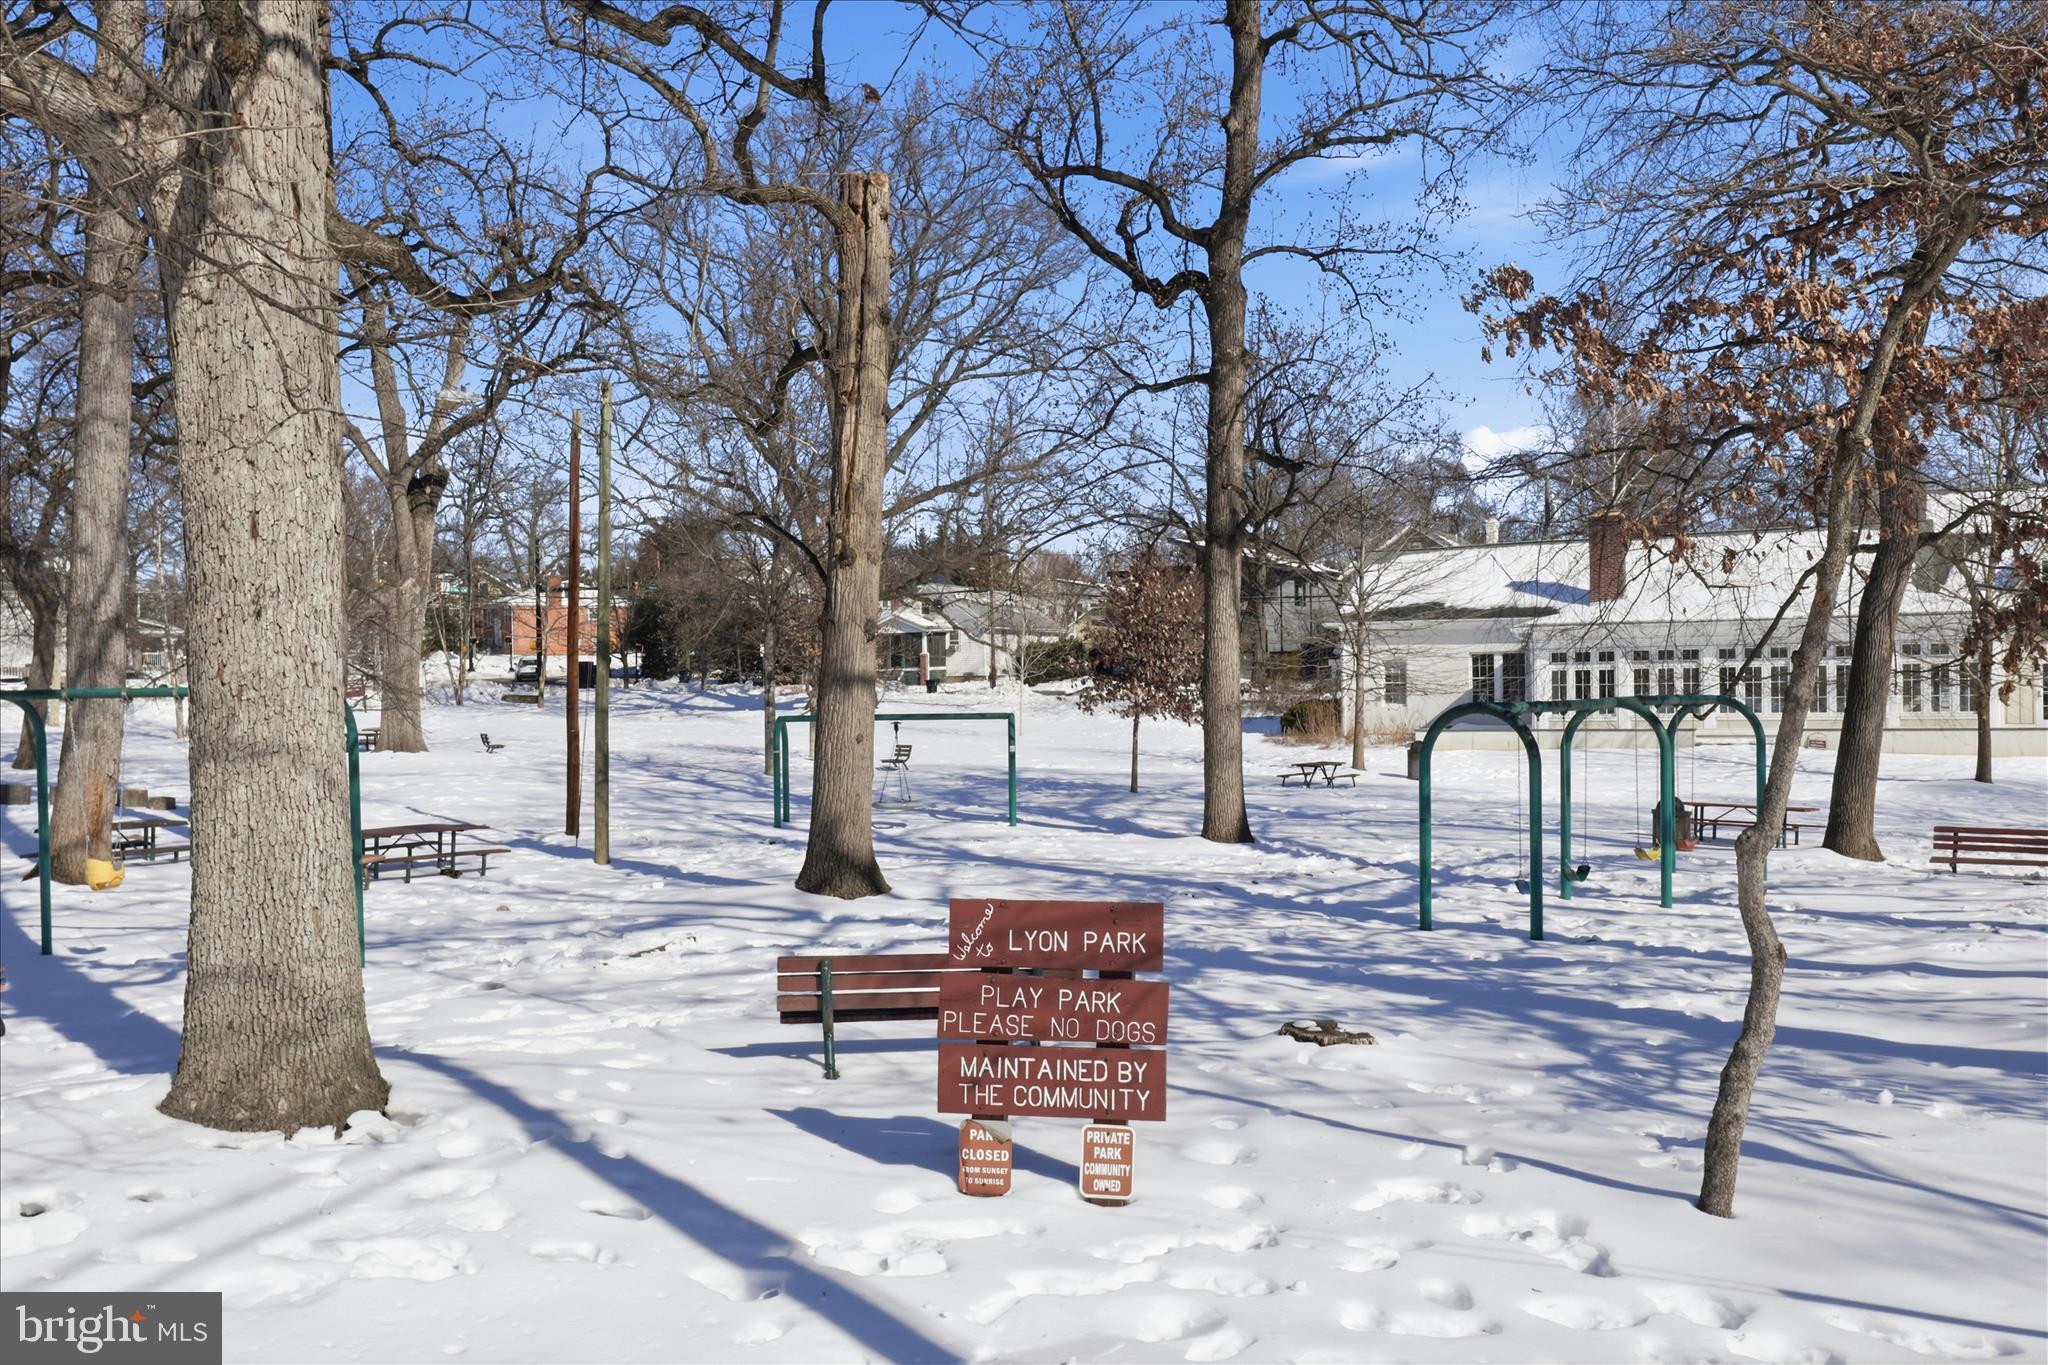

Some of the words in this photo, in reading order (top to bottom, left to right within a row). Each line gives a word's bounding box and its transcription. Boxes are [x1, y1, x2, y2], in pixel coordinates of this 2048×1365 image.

[953, 903, 994, 961] Welcome
[1009, 929, 1068, 952] LYON
[1083, 931, 1147, 954] PARK
[975, 942, 994, 957] to
[981, 985, 1043, 1009] PLAY
[1059, 989, 1122, 1014] PARK
[943, 1011, 1034, 1037] PLEASE
[1051, 1017, 1080, 1038] NO
[1096, 1019, 1156, 1043] DOGS
[960, 1056, 1108, 1083] MAINTAINED
[1118, 1061, 1148, 1084] BY
[959, 1083, 1004, 1107] THE
[1013, 1085, 1150, 1111] COMMUNITY
[969, 1128, 994, 1141] PAR
[1086, 1131, 1131, 1145] PRIVATE
[961, 1148, 1009, 1162] CLOSED
[1094, 1146, 1122, 1160] PARK
[982, 1167, 1009, 1175] SUNSET
[1084, 1163, 1131, 1177] COMMUNITY
[974, 1177, 1005, 1186] SUNRISE
[1093, 1179, 1121, 1193] OWNED
